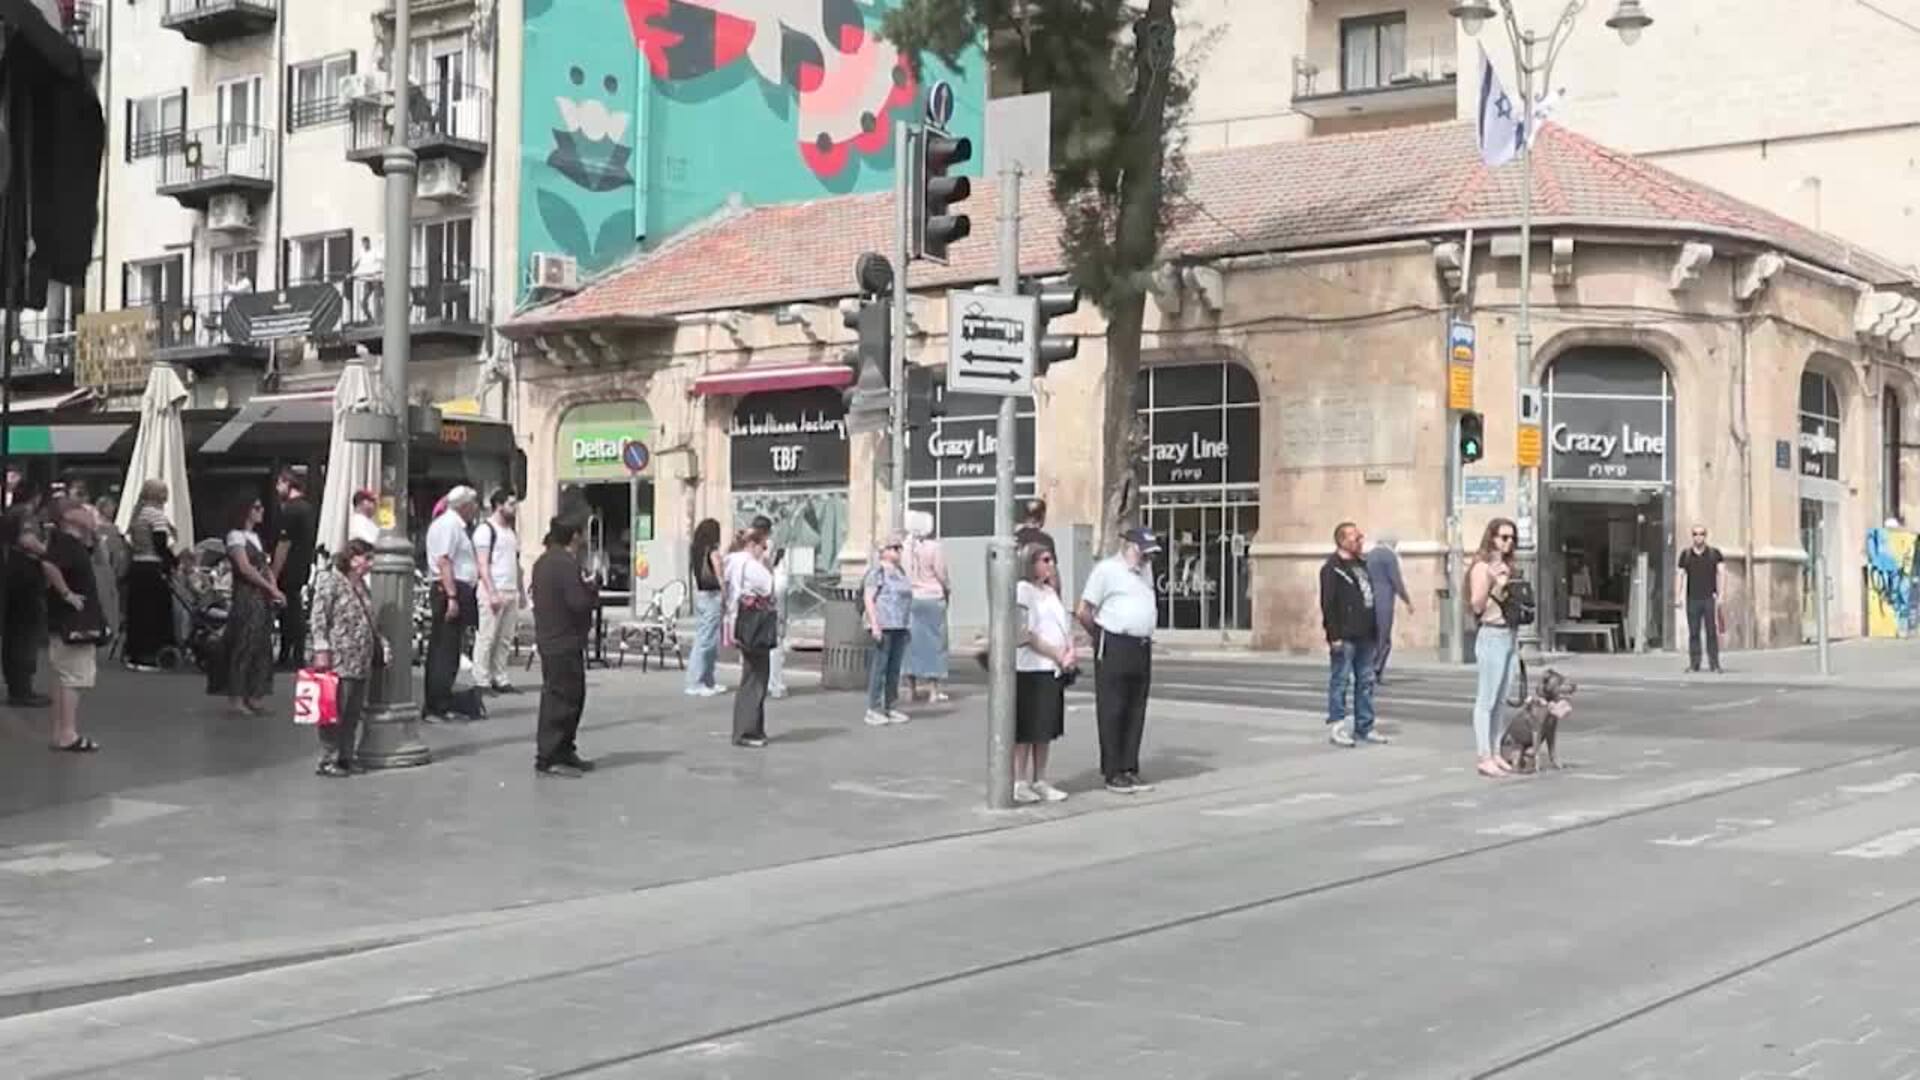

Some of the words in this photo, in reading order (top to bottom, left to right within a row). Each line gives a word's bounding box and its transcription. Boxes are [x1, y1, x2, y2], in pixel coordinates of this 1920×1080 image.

[572, 438, 618, 461] Delta
[928, 430, 974, 460] Crazy
[1192, 431, 1227, 460] Line
[1551, 422, 1617, 458] Crazy
[1623, 423, 1664, 454] Line
[769, 444, 804, 473] TBF
